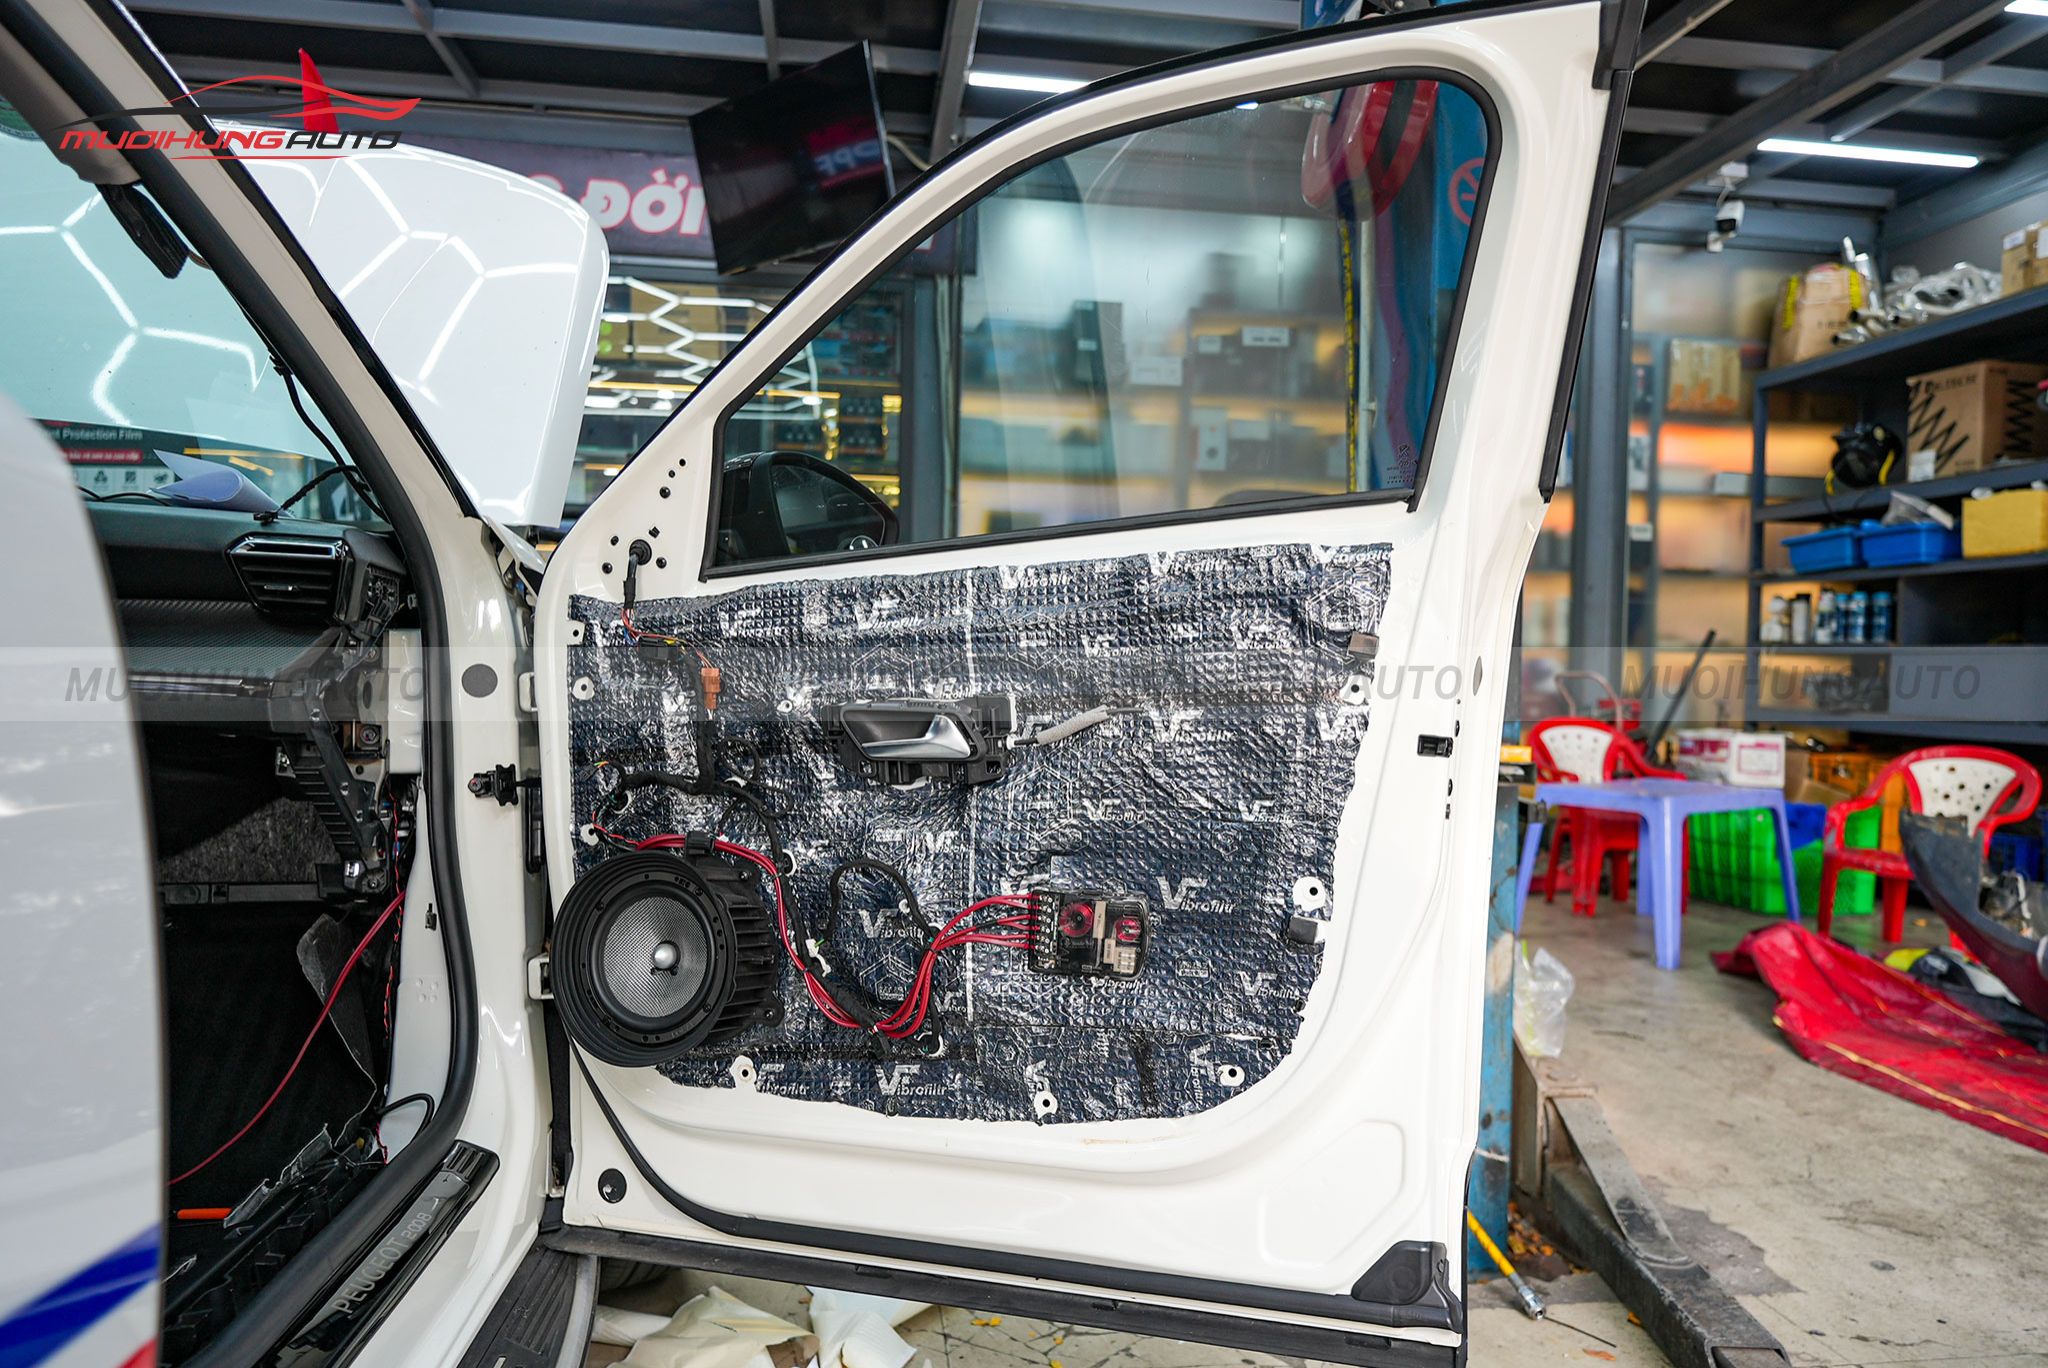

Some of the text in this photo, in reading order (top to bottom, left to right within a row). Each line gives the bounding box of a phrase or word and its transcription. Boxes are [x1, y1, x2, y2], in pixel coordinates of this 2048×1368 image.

[62, 429, 117, 441] Protection
[119, 430, 143, 441] Film
[874, 1063, 948, 1097] Vibrofiltr
[332, 1212, 432, 1314] PEUGEOT 2008
